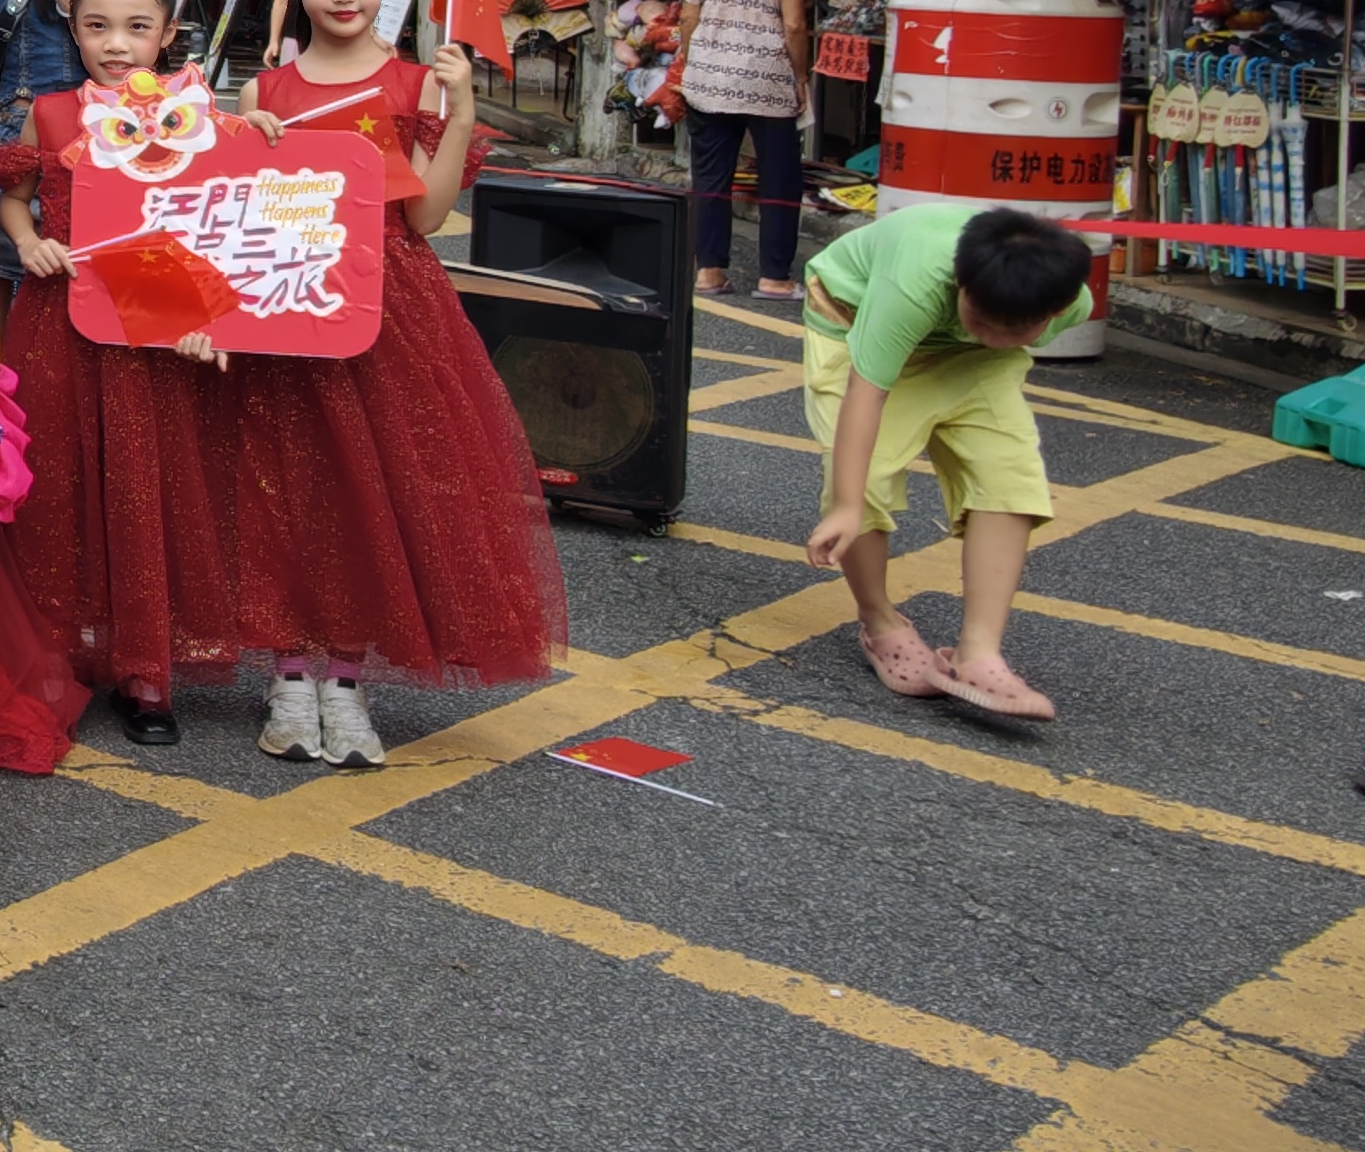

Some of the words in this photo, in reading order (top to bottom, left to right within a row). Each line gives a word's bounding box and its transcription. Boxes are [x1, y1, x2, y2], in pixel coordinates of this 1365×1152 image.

[256, 174, 339, 198] Happiness
[150, 182, 253, 230] 江門
[260, 201, 329, 224] Happens
[298, 226, 341, 245] Here
